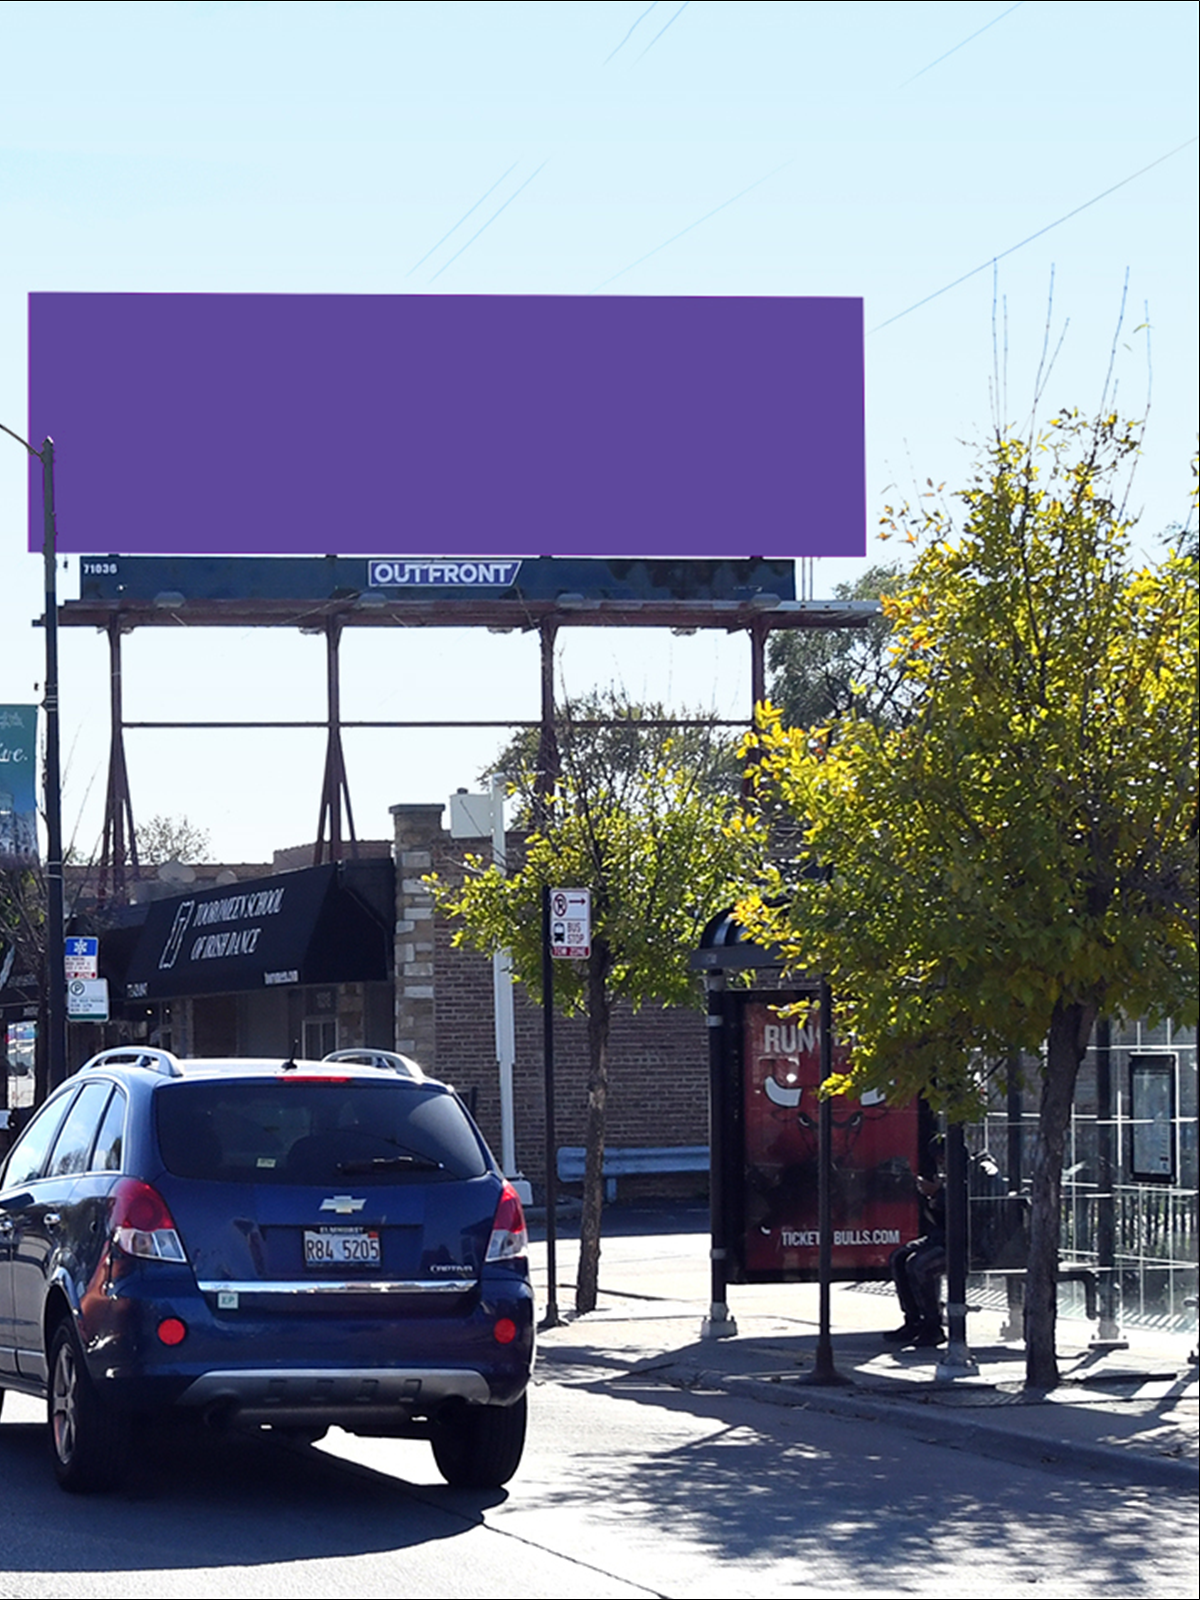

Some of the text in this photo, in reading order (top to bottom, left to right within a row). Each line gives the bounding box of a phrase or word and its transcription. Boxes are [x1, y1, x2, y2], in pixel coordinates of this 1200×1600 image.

[374, 564, 512, 583] OUTFRONT
[243, 887, 285, 918] SCHOOL
[567, 922, 581, 933] BUS
[201, 932, 230, 959] IRISH
[225, 928, 262, 957] DANCE
[567, 934, 585, 944] STOP
[764, 1025, 813, 1053] RUN
[782, 1231, 821, 1246] TICKET
[306, 1240, 379, 1260] R84 5205
